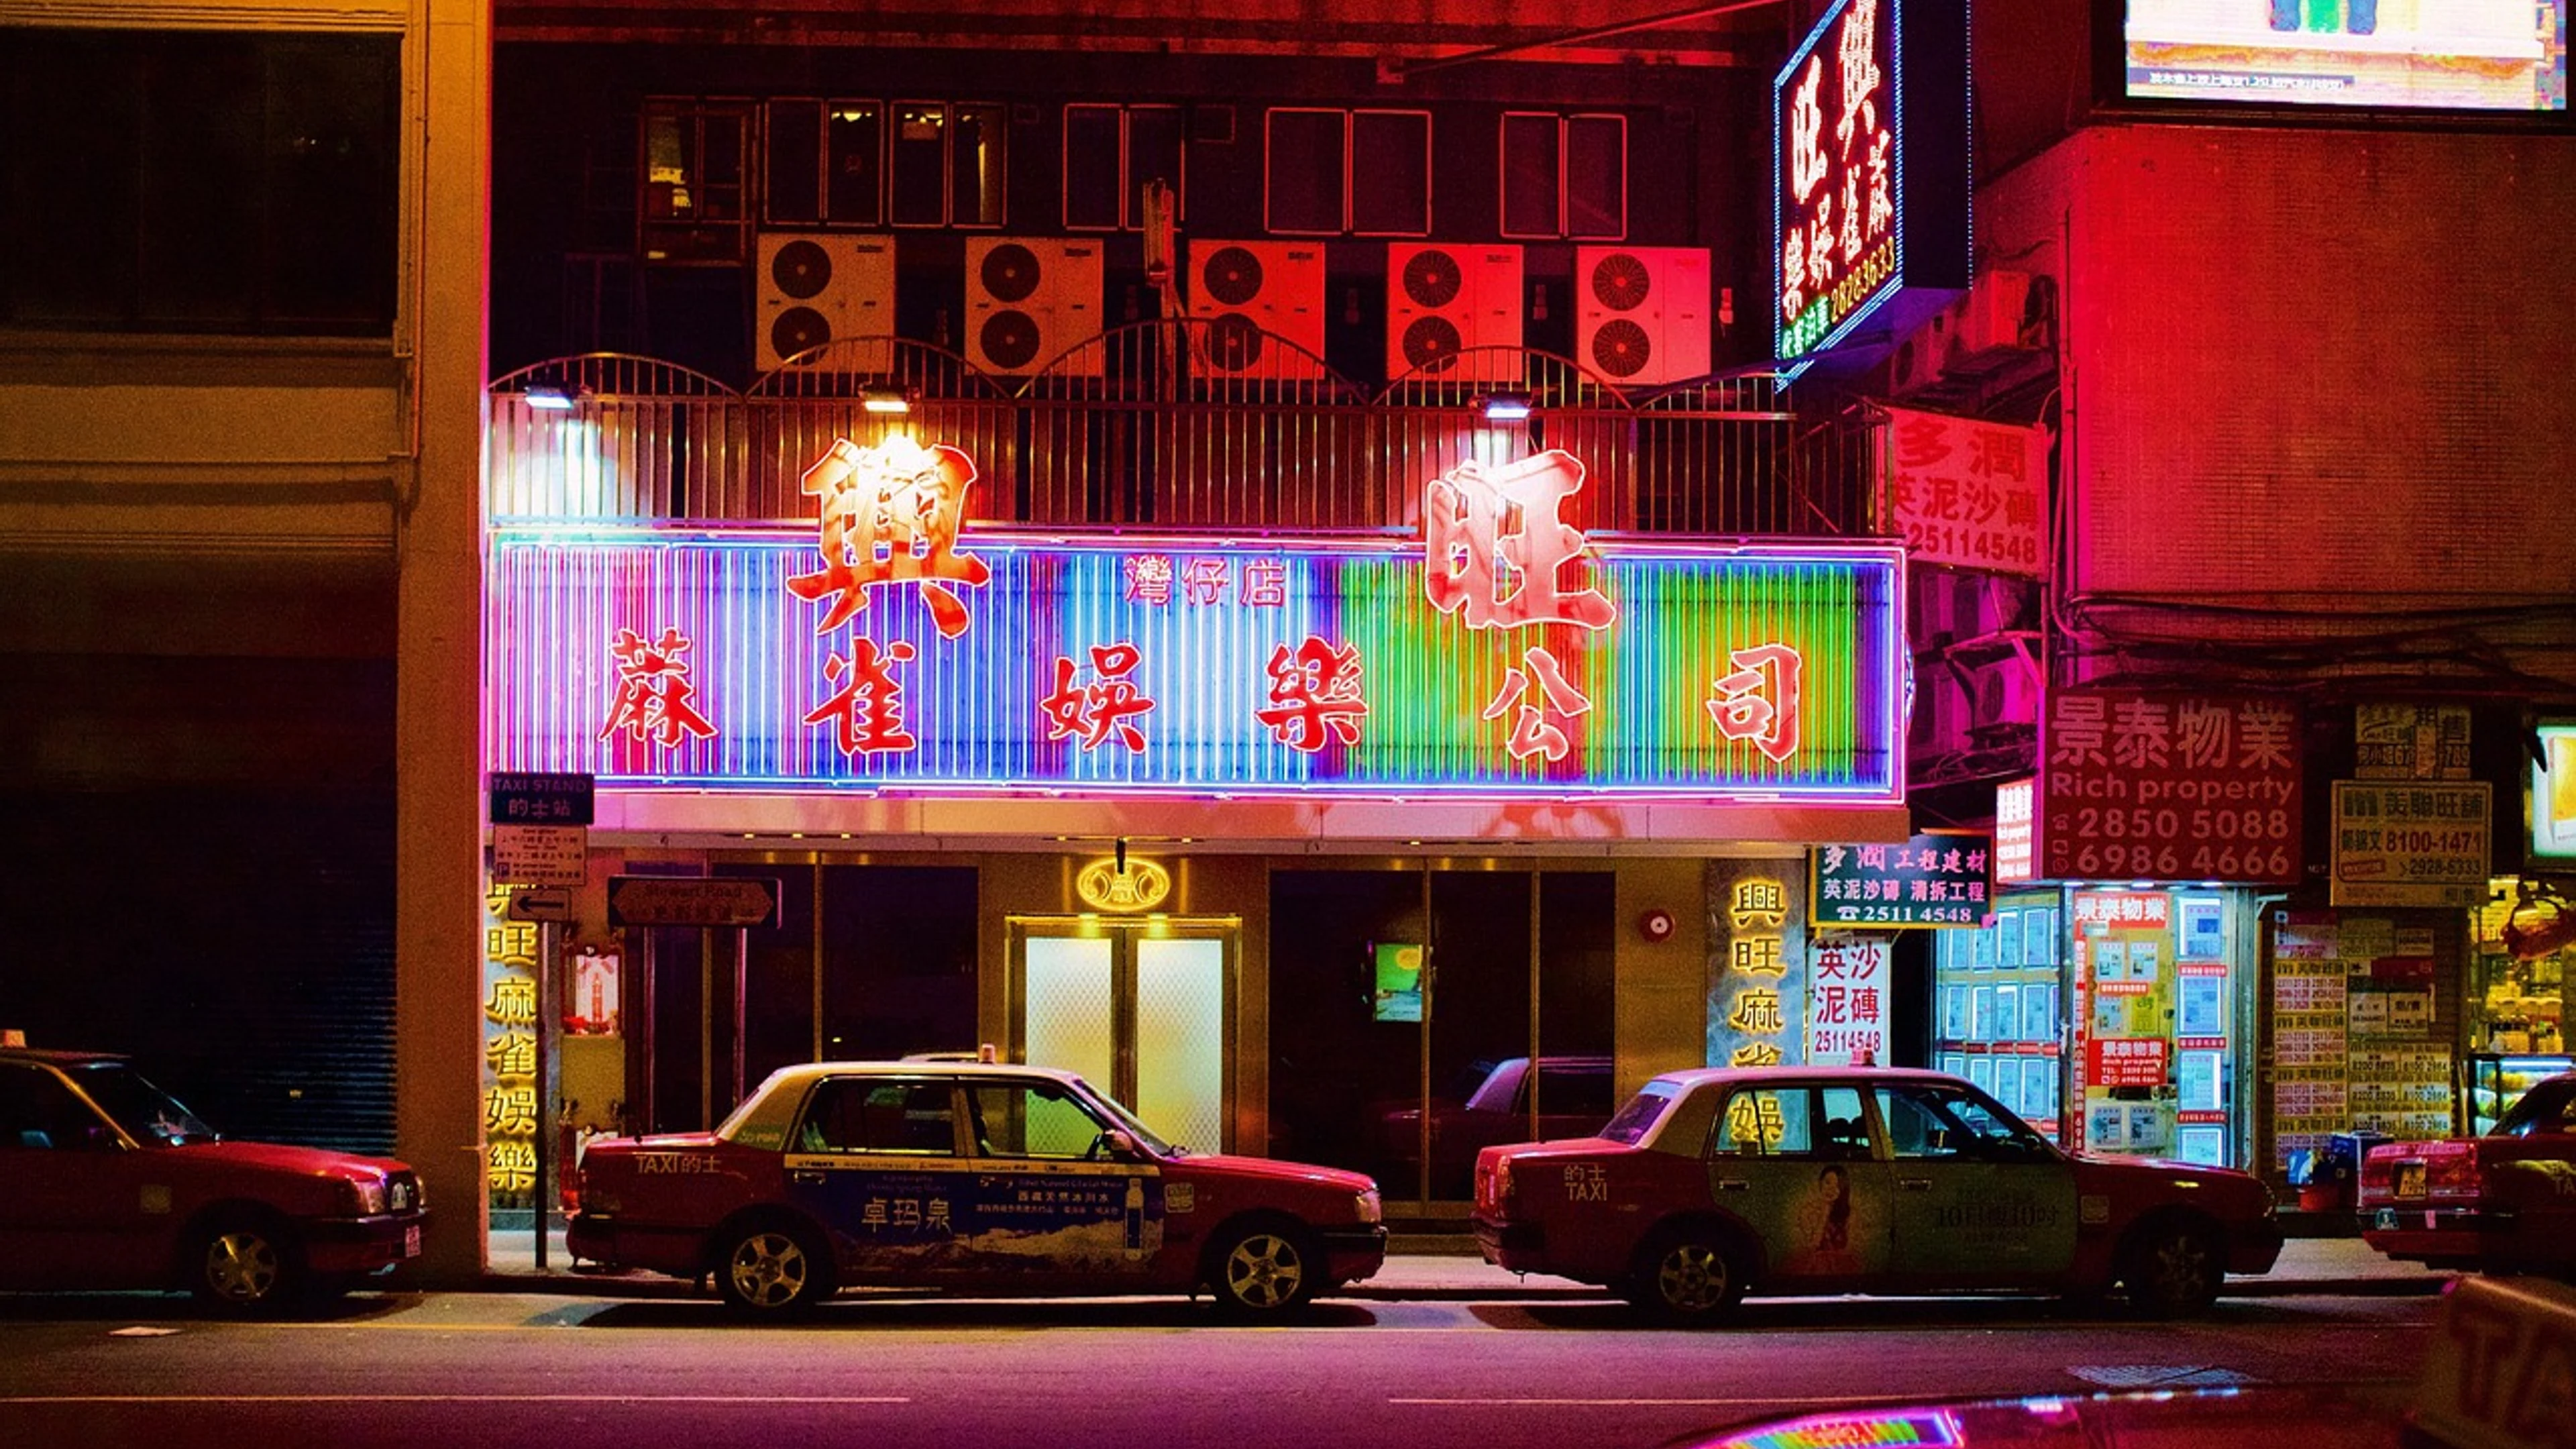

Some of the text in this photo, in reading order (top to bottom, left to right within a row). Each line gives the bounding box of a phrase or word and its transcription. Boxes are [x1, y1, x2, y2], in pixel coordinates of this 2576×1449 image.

[1831, 236, 1894, 323] 28283633
[1898, 417, 2026, 482] 多潤
[1909, 522, 2038, 565] 25114548
[1125, 553, 1287, 606] 灣仔店
[2051, 696, 2294, 769] 景泰物業
[493, 778, 587, 793] TAXI STAND
[2051, 771, 2294, 805] Rich property
[508, 798, 572, 820] 的士站
[2079, 808, 2290, 839] 2850 5088
[2385, 830, 2481, 853] 8100-1471
[1894, 848, 1987, 873] 工程建材
[2079, 844, 2290, 875] 6986 4666
[1823, 879, 1985, 902] 英泥沙磚 清拆工程
[1864, 906, 1972, 923] 2511 4548
[1815, 1030, 1881, 1053] 25114548
[1564, 1163, 1607, 1181] 的士
[1565, 1182, 1607, 1201] TAXI
